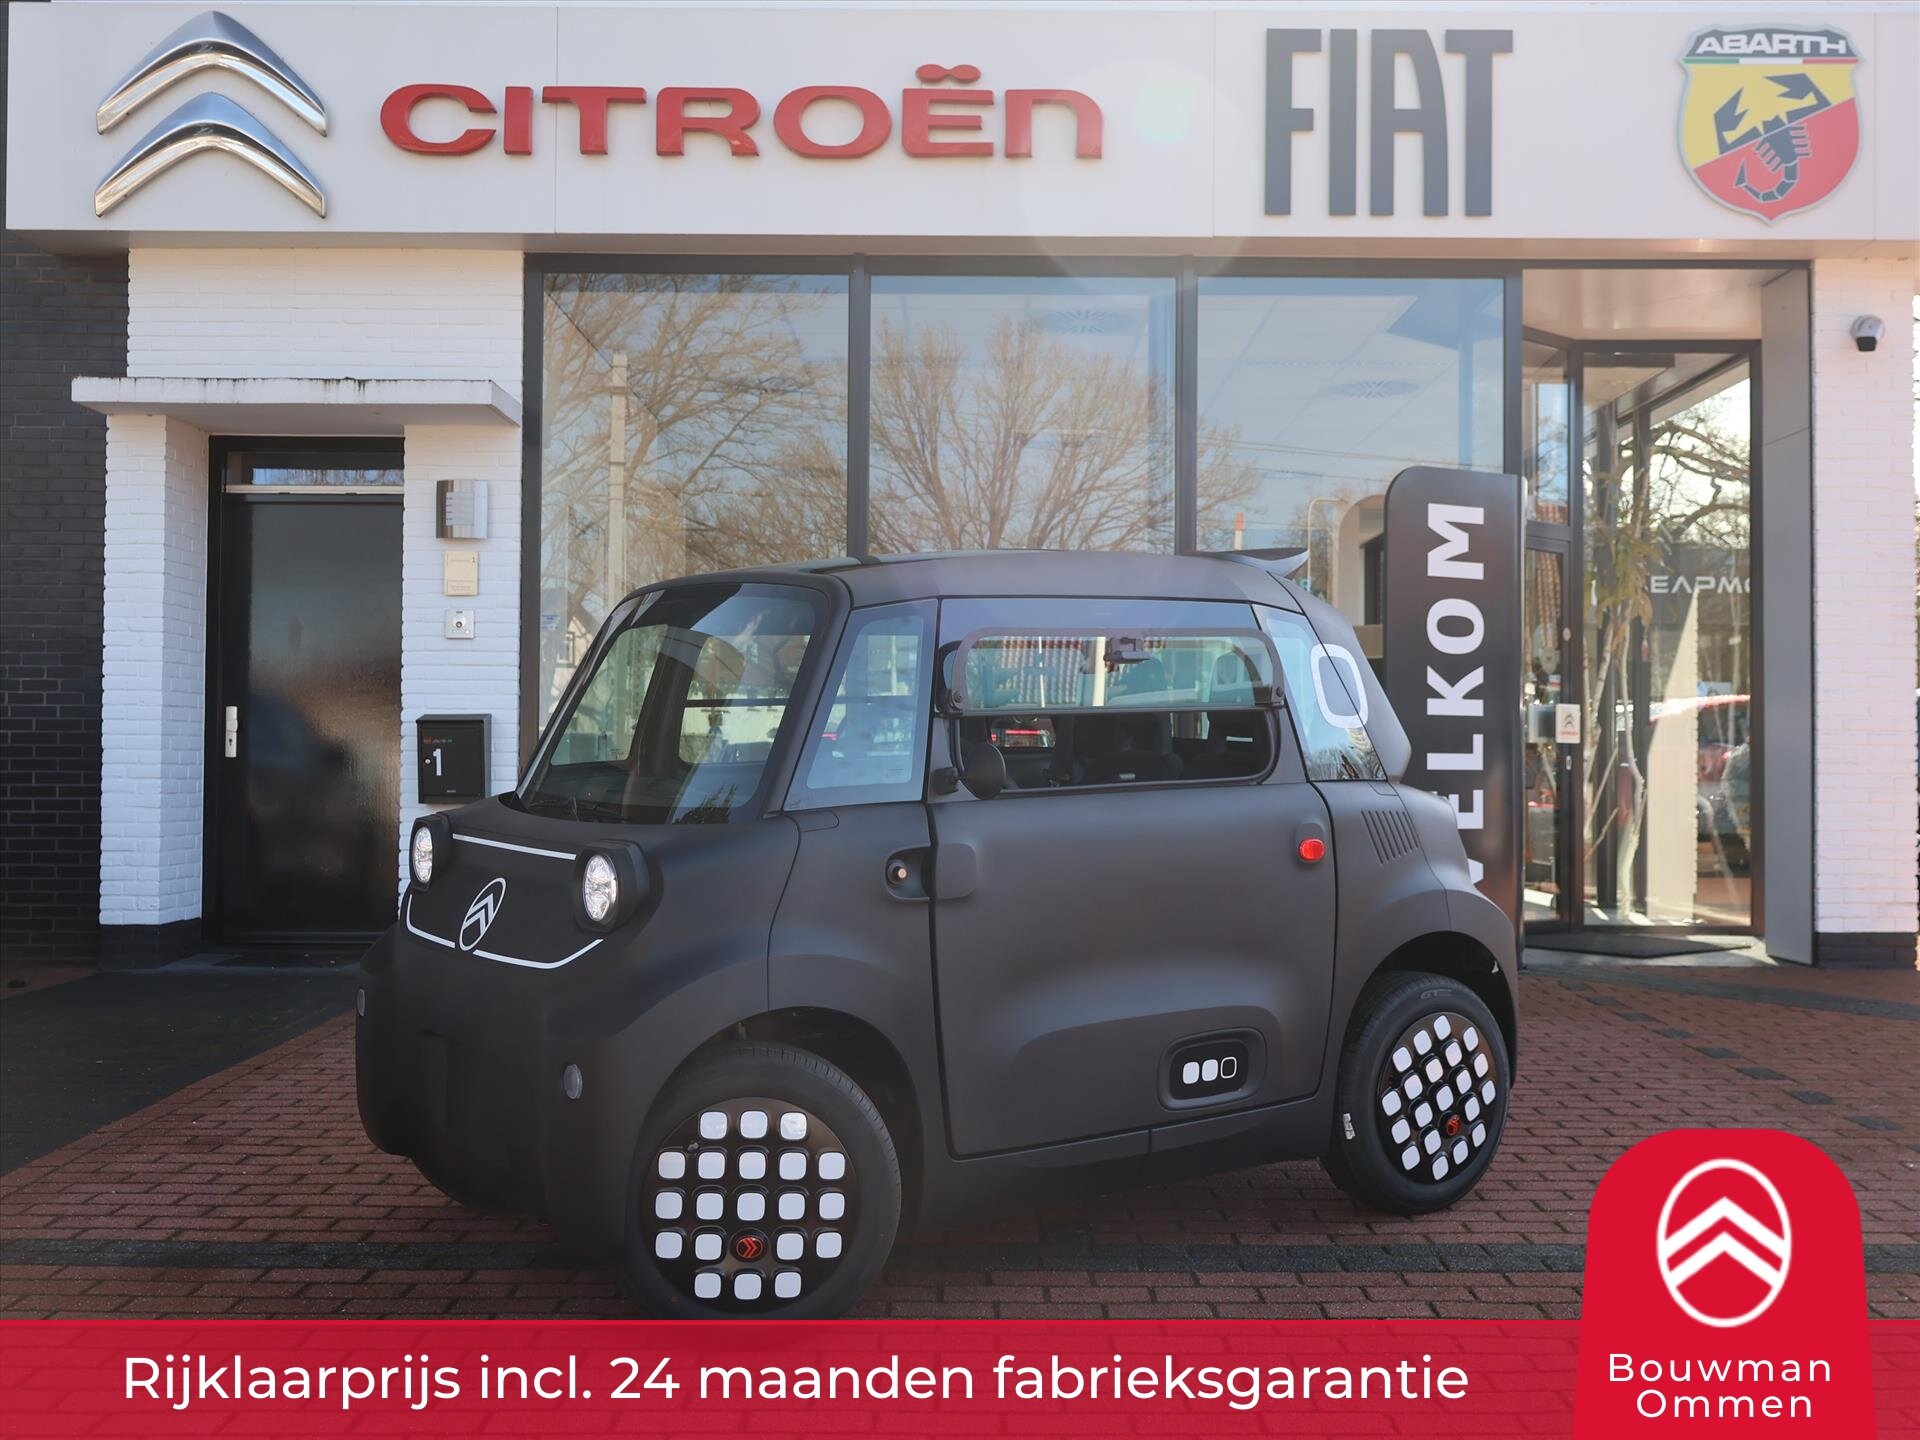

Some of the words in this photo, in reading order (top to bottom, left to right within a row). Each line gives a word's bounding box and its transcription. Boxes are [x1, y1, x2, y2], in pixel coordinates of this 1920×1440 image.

[1696, 33, 1846, 54] ABARTH
[1264, 28, 1514, 218] FIAT
[1644, 575, 1751, 594] EAPM
[1426, 502, 1485, 886] ELKOM
[433, 748, 442, 776] 1
